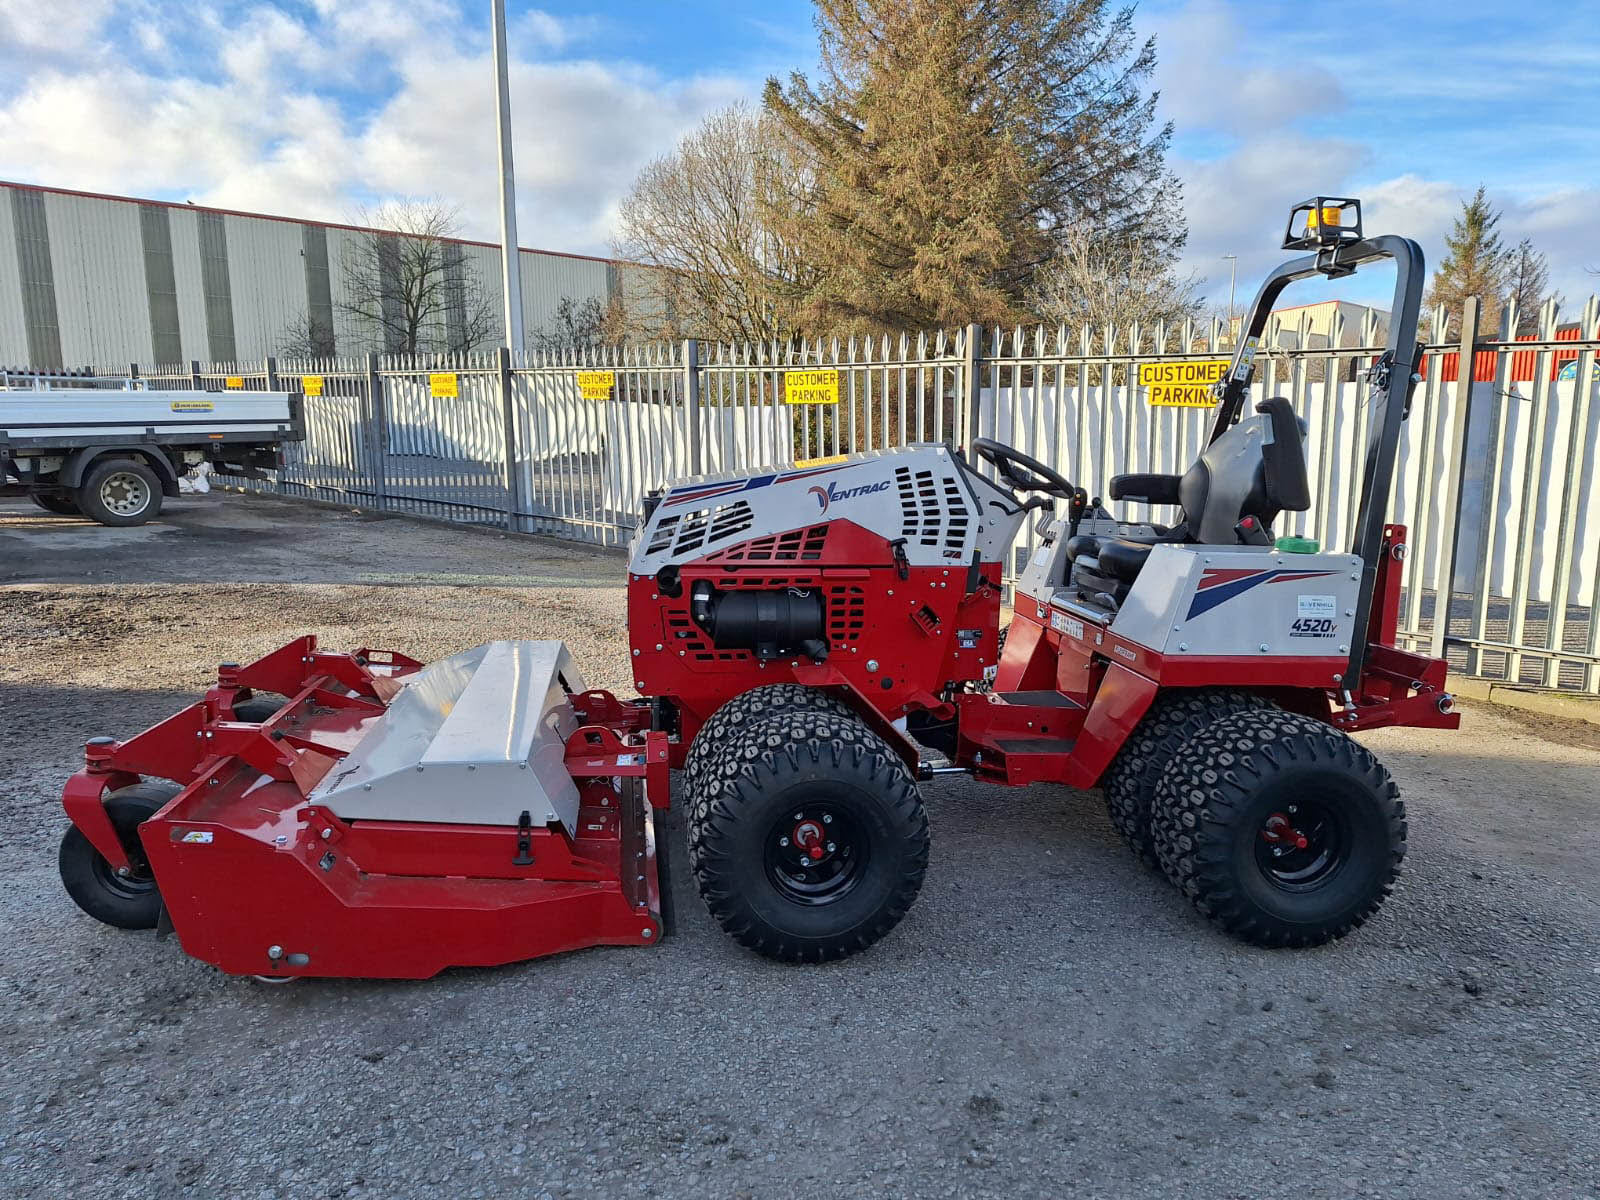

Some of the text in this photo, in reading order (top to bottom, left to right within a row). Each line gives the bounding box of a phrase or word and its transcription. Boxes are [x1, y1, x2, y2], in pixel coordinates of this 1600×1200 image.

[578, 373, 612, 384] CUSTOMER
[1144, 364, 1229, 382] CUSTOMER
[787, 373, 836, 386] CUSTOMER
[583, 386, 609, 397] PARKING
[791, 389, 831, 401] PARKING
[808, 481, 891, 516] VENTRAC
